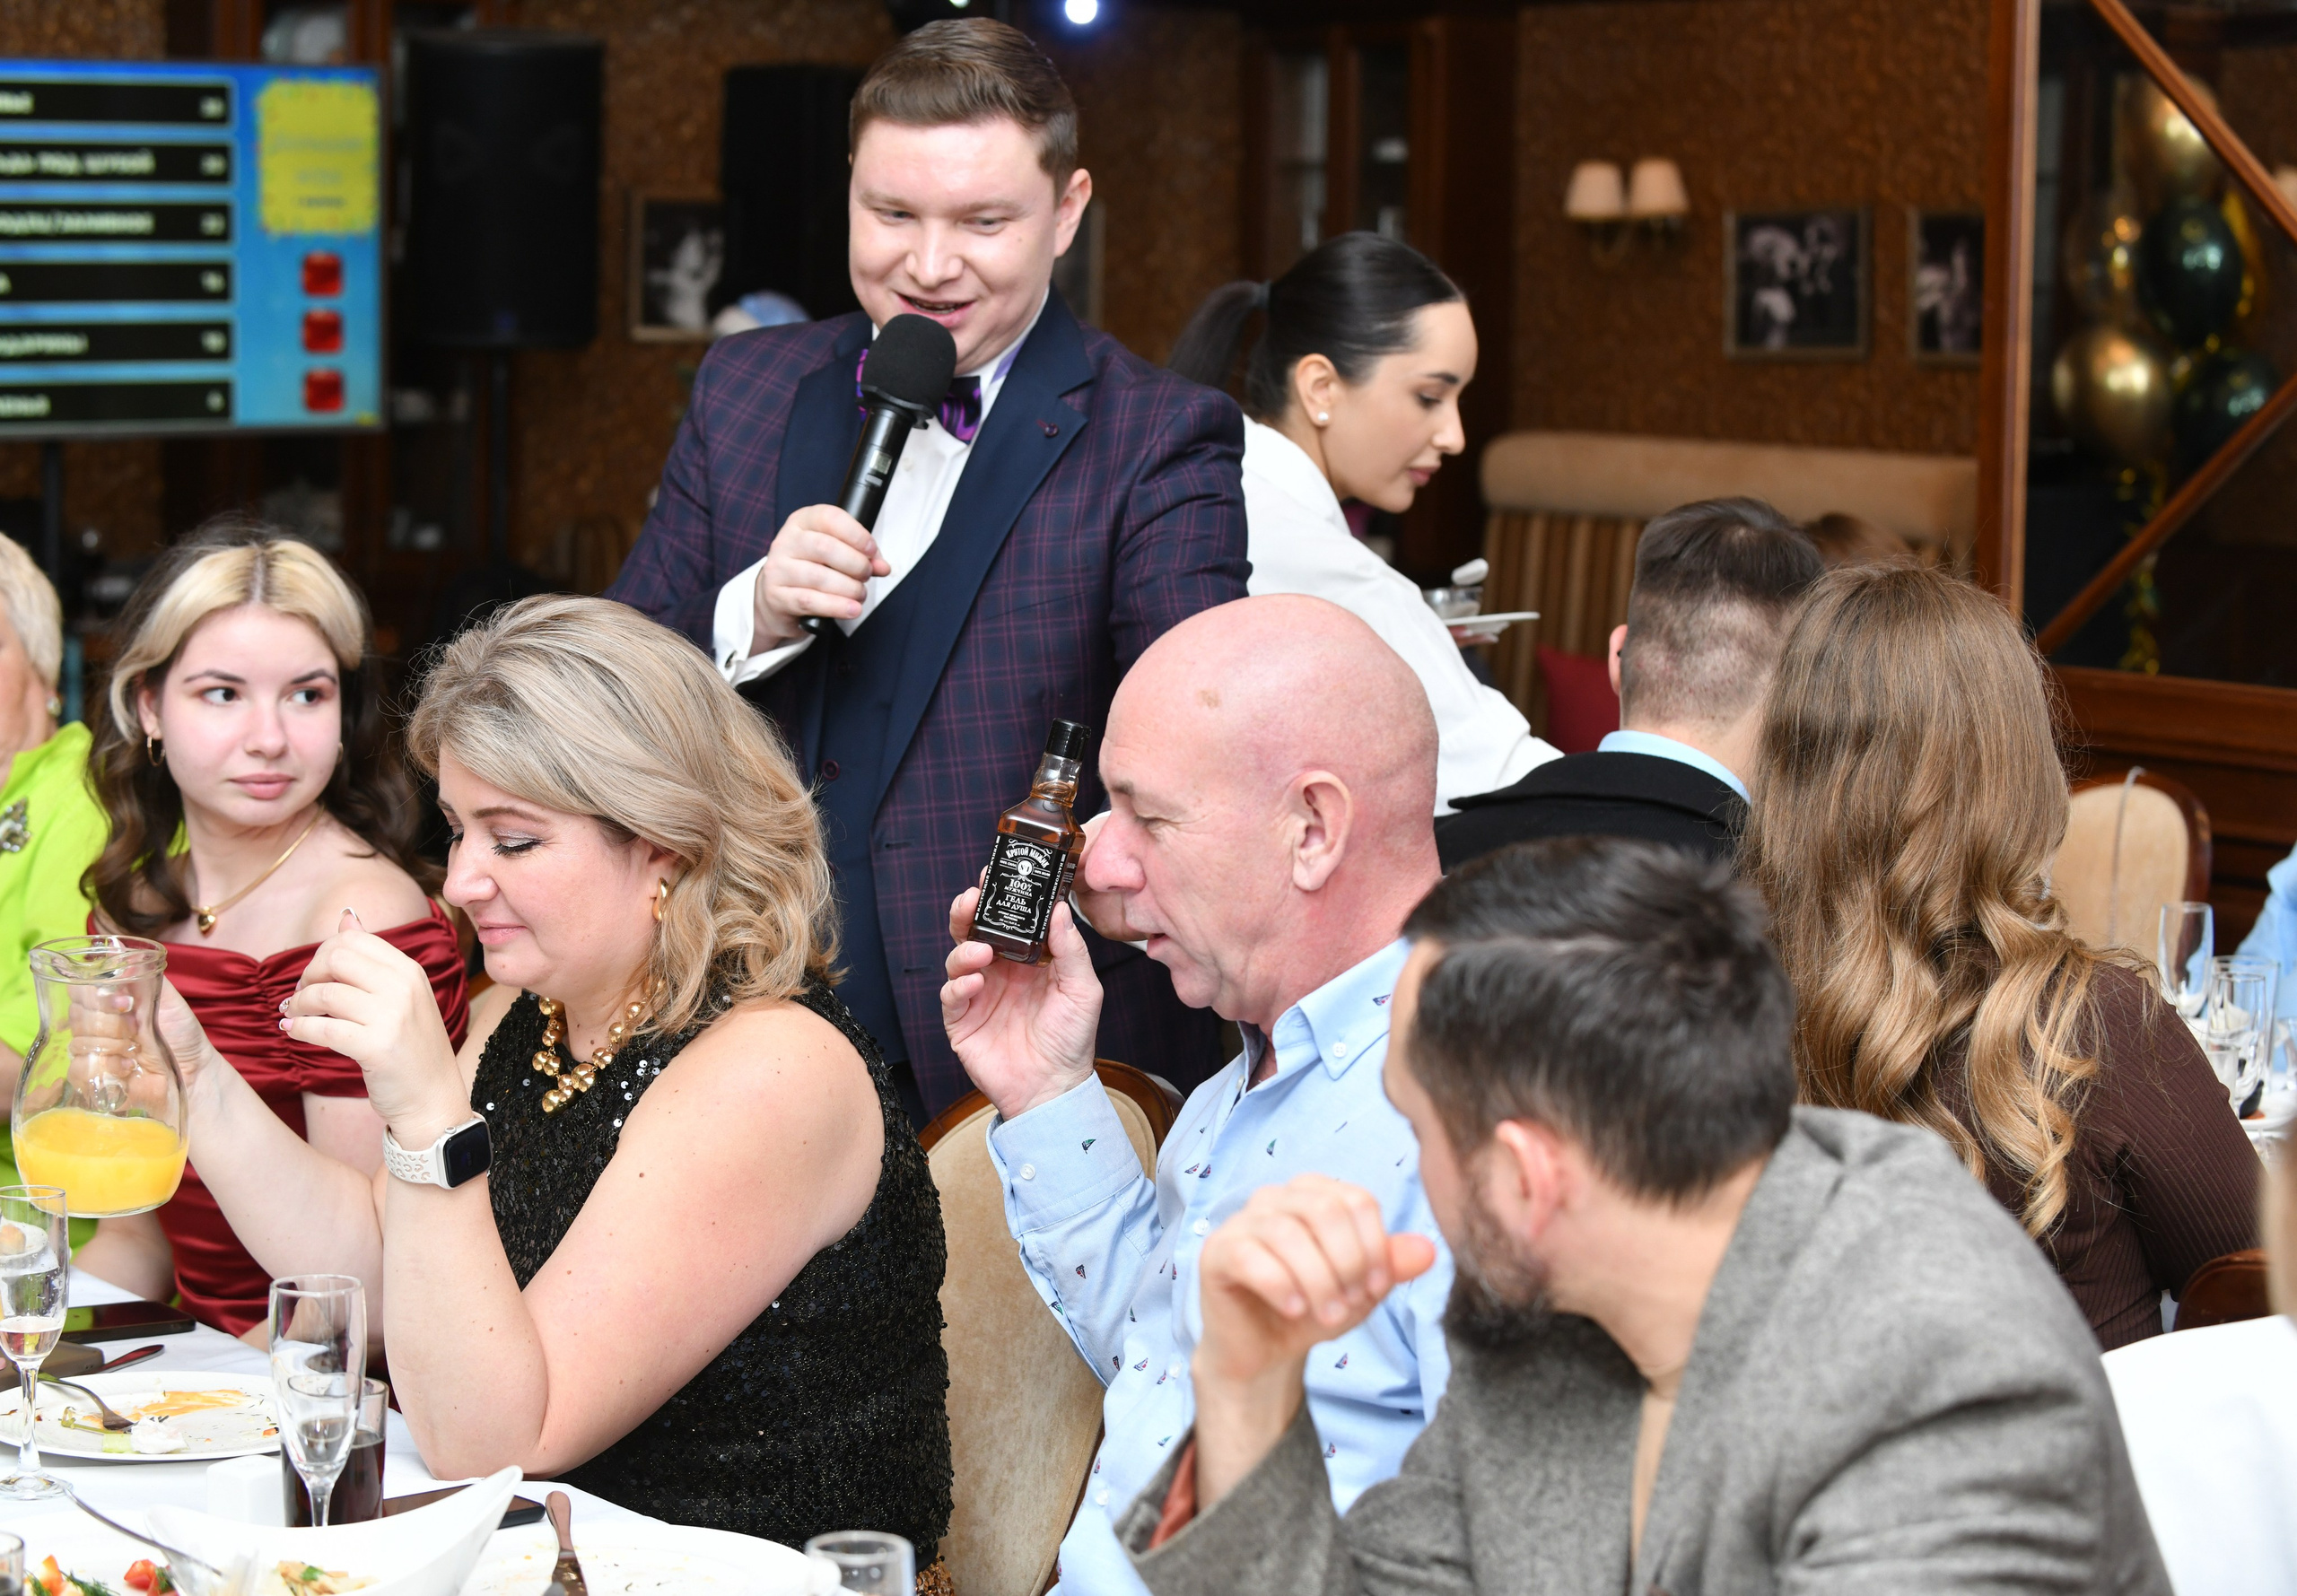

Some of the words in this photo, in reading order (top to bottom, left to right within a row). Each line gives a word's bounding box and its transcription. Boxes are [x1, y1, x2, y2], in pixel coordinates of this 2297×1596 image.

[1006, 847, 1029, 859] КРУТОЙ
[1029, 849, 1050, 868] МУЖИК
[977, 875, 990, 912] НАСТОЯЩИЙ
[988, 844, 999, 875] МУЖЧИНА
[1009, 878, 1032, 893] 100%
[1051, 862, 1063, 900] НАСТОЯЩИЙ
[1004, 885, 1032, 897] МУЖЧИНА
[1005, 894, 1026, 905] ГЕЛЬ
[996, 899, 1011, 908] ДЛЯ
[1011, 903, 1032, 914] ДУША
[1042, 901, 1052, 930] МУЖЧИНА
